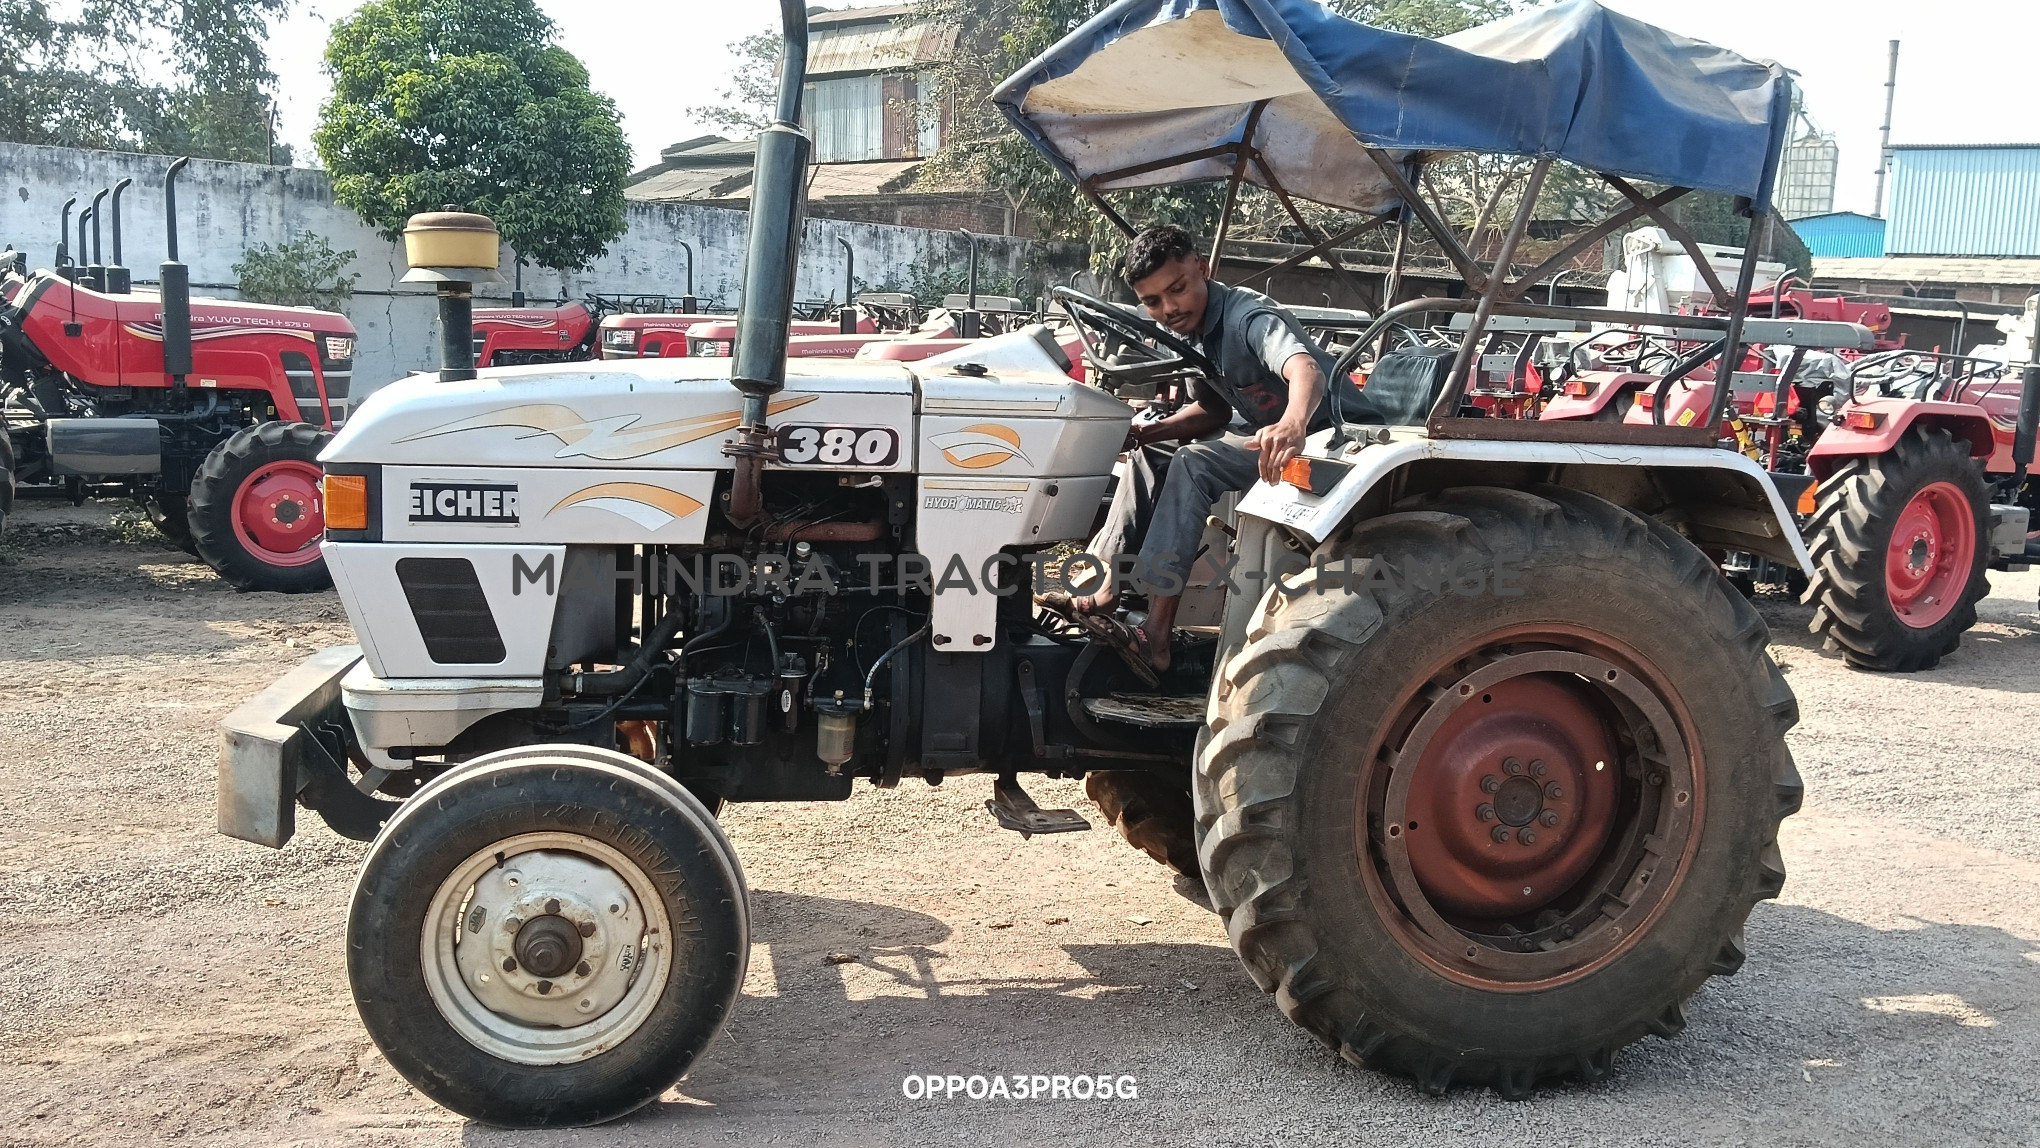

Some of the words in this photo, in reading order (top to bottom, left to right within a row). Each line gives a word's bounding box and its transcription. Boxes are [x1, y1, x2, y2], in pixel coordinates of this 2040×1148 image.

[207, 315, 241, 324] YUVO
[243, 317, 274, 326] TECH
[784, 428, 892, 464] 380
[409, 489, 520, 517] EICHER
